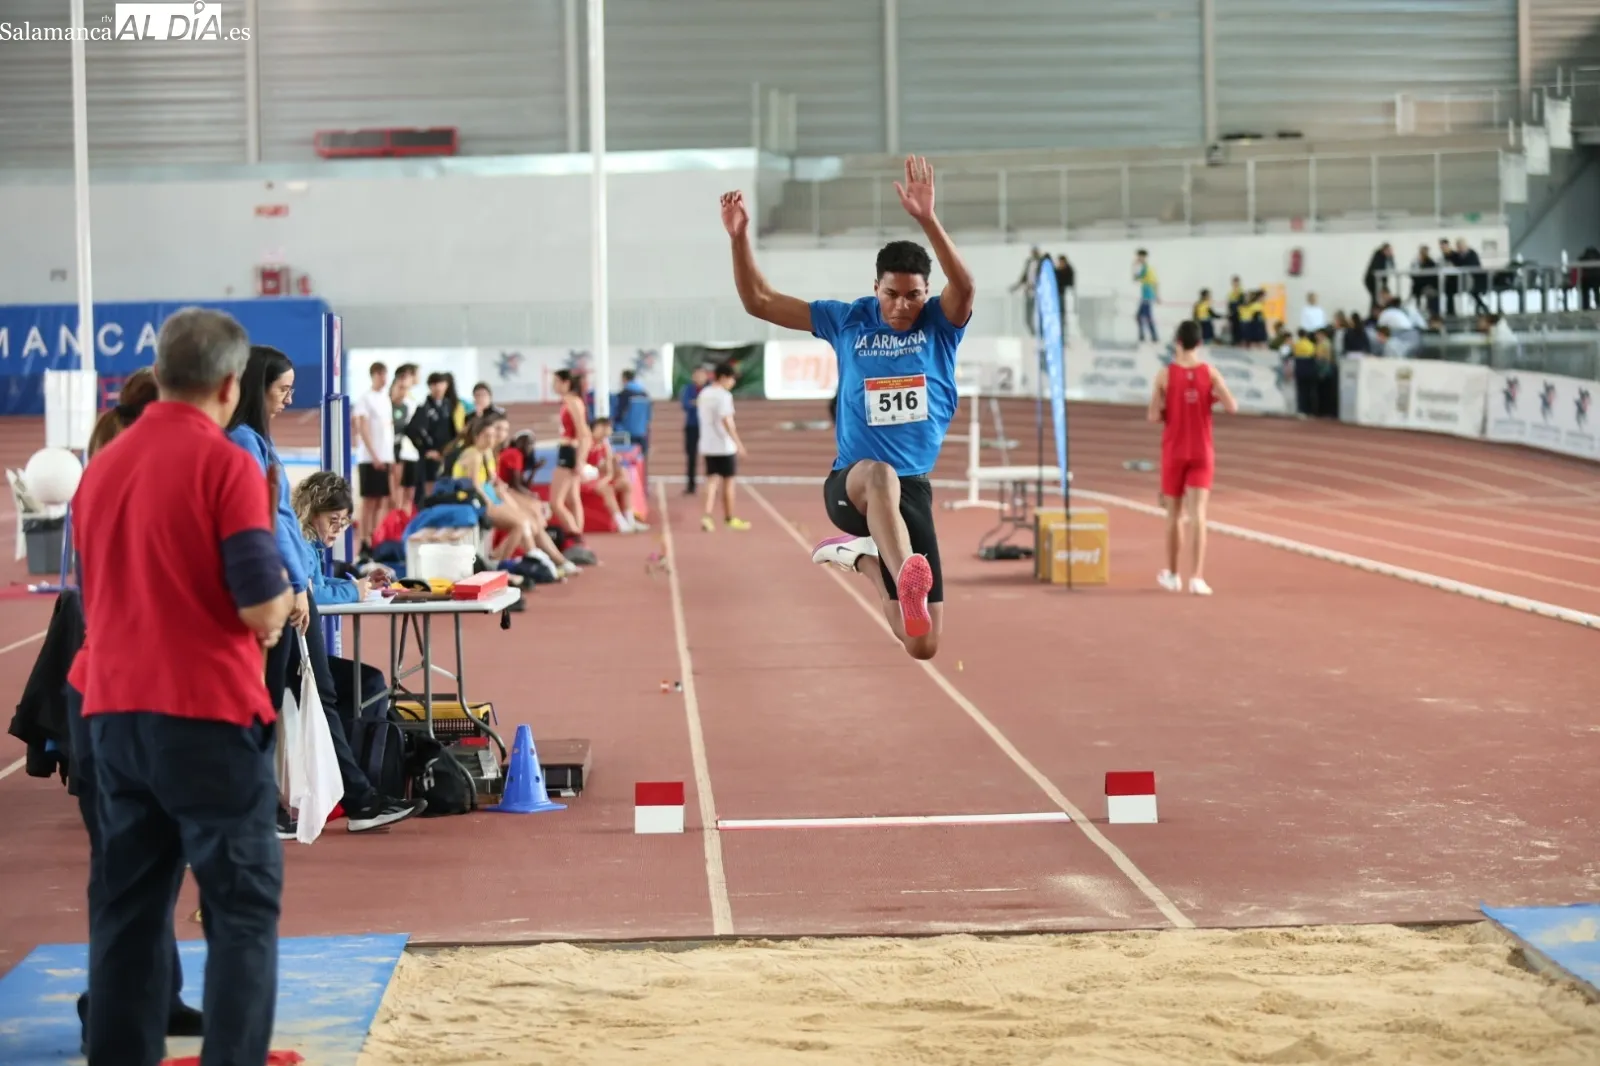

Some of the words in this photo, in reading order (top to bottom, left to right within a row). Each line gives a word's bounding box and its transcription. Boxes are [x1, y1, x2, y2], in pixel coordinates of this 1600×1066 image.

[854, 334, 868, 350] LA
[871, 329, 928, 350] ARMUÑA
[858, 349, 878, 357] CLUB
[879, 345, 923, 358] DEPORTIVO
[878, 390, 918, 413] 516
